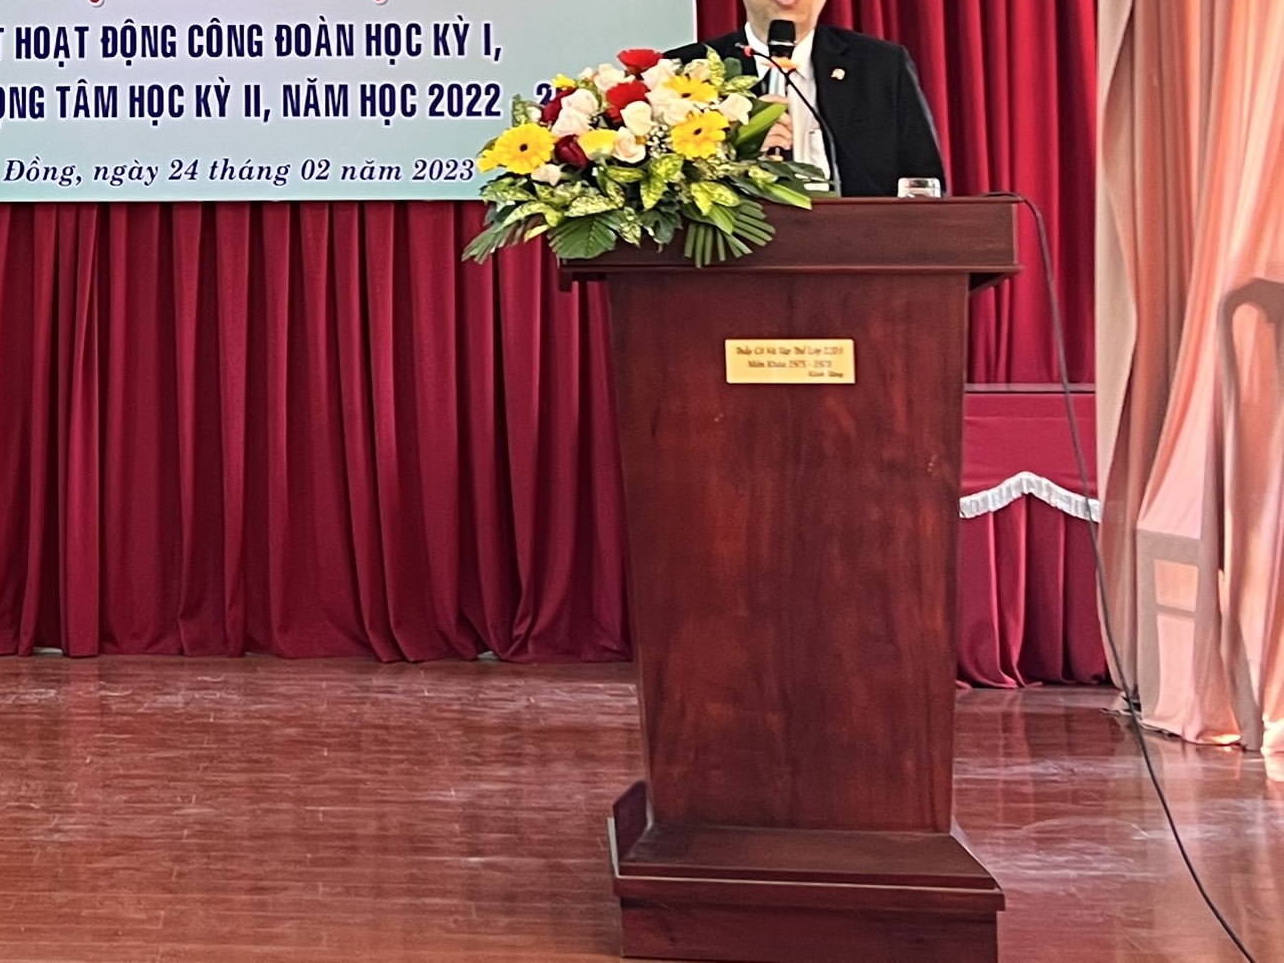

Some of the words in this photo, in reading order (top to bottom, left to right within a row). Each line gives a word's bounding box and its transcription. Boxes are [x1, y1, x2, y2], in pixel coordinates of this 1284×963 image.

[15, 25, 89, 67] HOẠT
[100, 18, 176, 66] ĐỘNG
[187, 17, 262, 57] CÔNG
[274, 15, 353, 57] ĐOÀN
[365, 22, 421, 65] HỌC
[433, 14, 469, 55] KỲ
[483, 23, 501, 61] I,
[55, 78, 117, 118] TÂM
[129, 84, 184, 126] HỌC
[195, 76, 230, 117] KỲ
[244, 84, 270, 122] II,
[282, 77, 348, 117] NĂM
[360, 83, 416, 125] HỌC
[428, 83, 500, 117] 2022
[4, 159, 81, 186] Đồng,
[93, 160, 158, 186] ngày
[168, 159, 198, 180] 24
[209, 158, 290, 186] tháng
[301, 159, 330, 179] 02
[341, 160, 400, 180] năm
[412, 159, 473, 180] 2023
